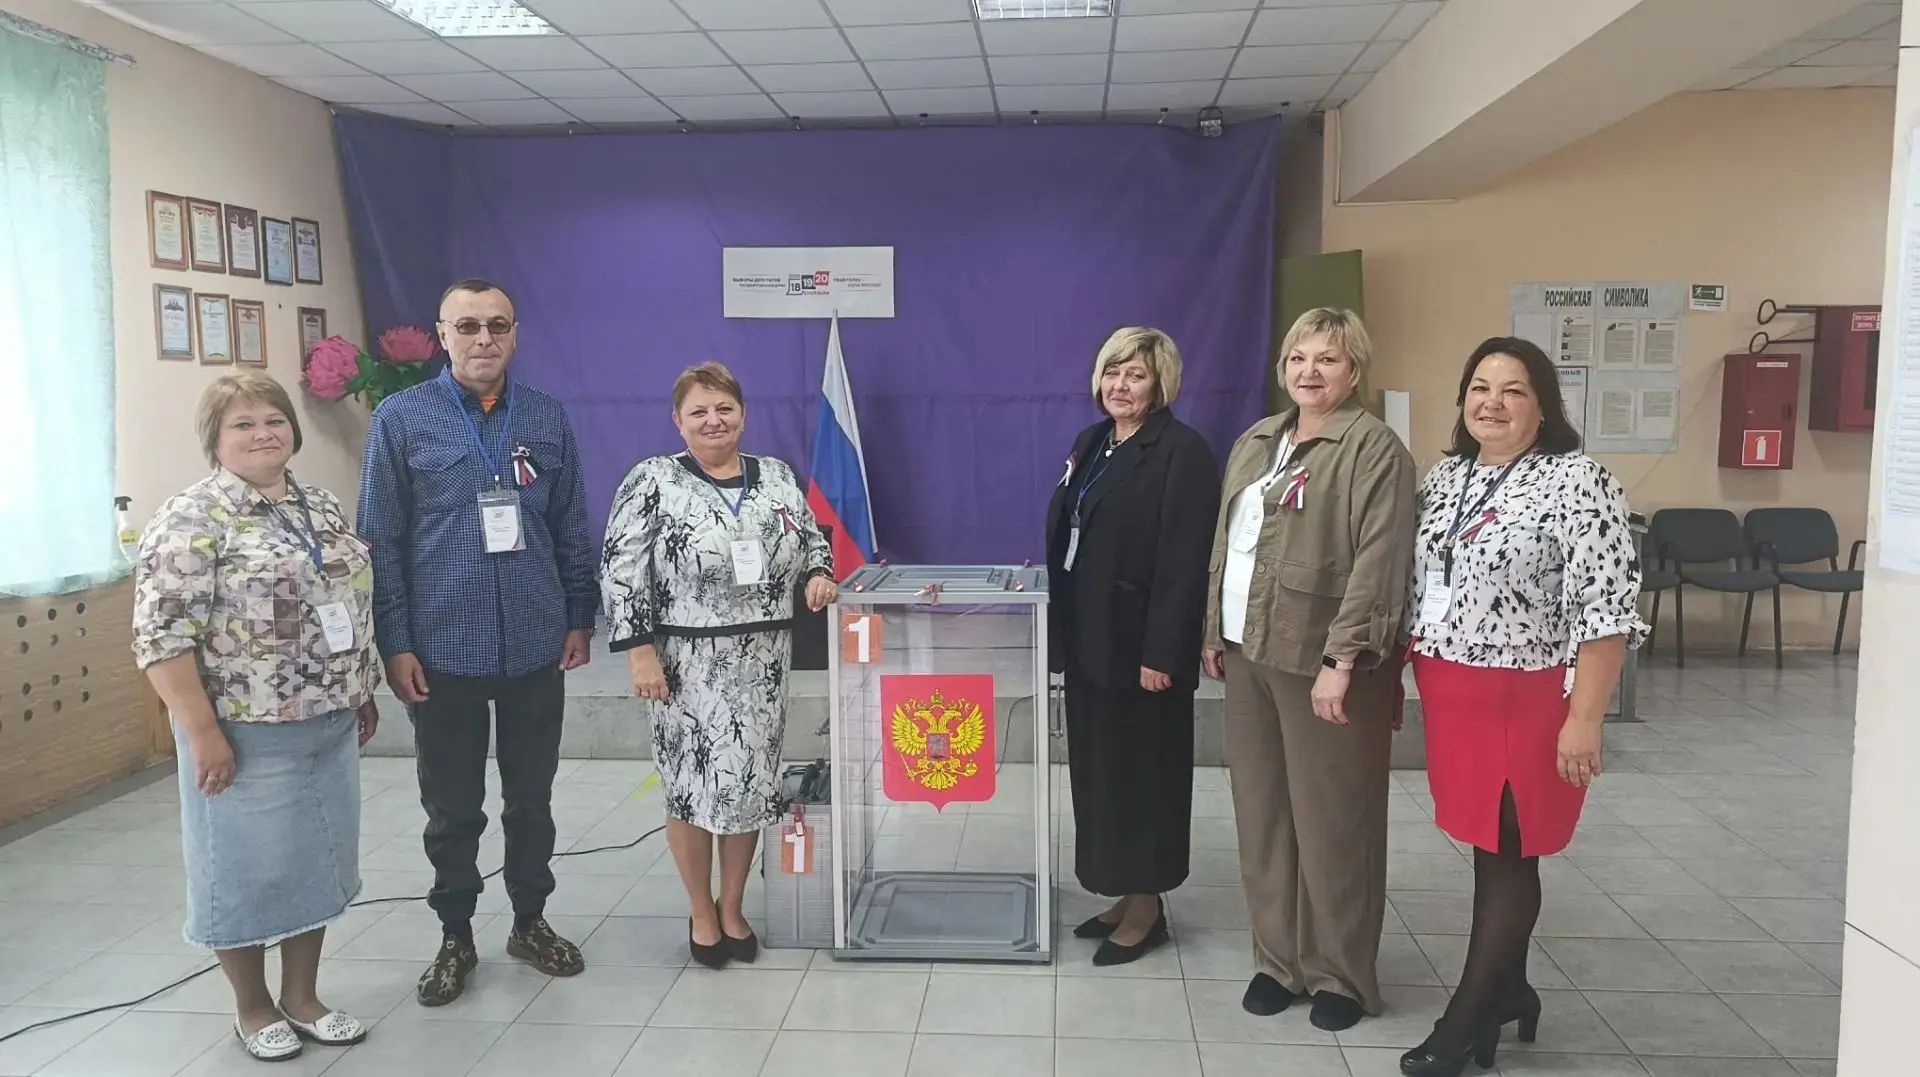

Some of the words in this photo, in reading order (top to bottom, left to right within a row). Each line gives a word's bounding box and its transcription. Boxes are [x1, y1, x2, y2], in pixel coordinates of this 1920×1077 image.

[804, 279, 812, 288] 19
[815, 274, 828, 283] 20
[791, 283, 801, 291] 18
[1544, 288, 1592, 307] РОССИЙСКАЯ
[1604, 288, 1649, 307] СИМВОЛИКА
[848, 616, 870, 663] 1
[784, 829, 806, 873] 1
